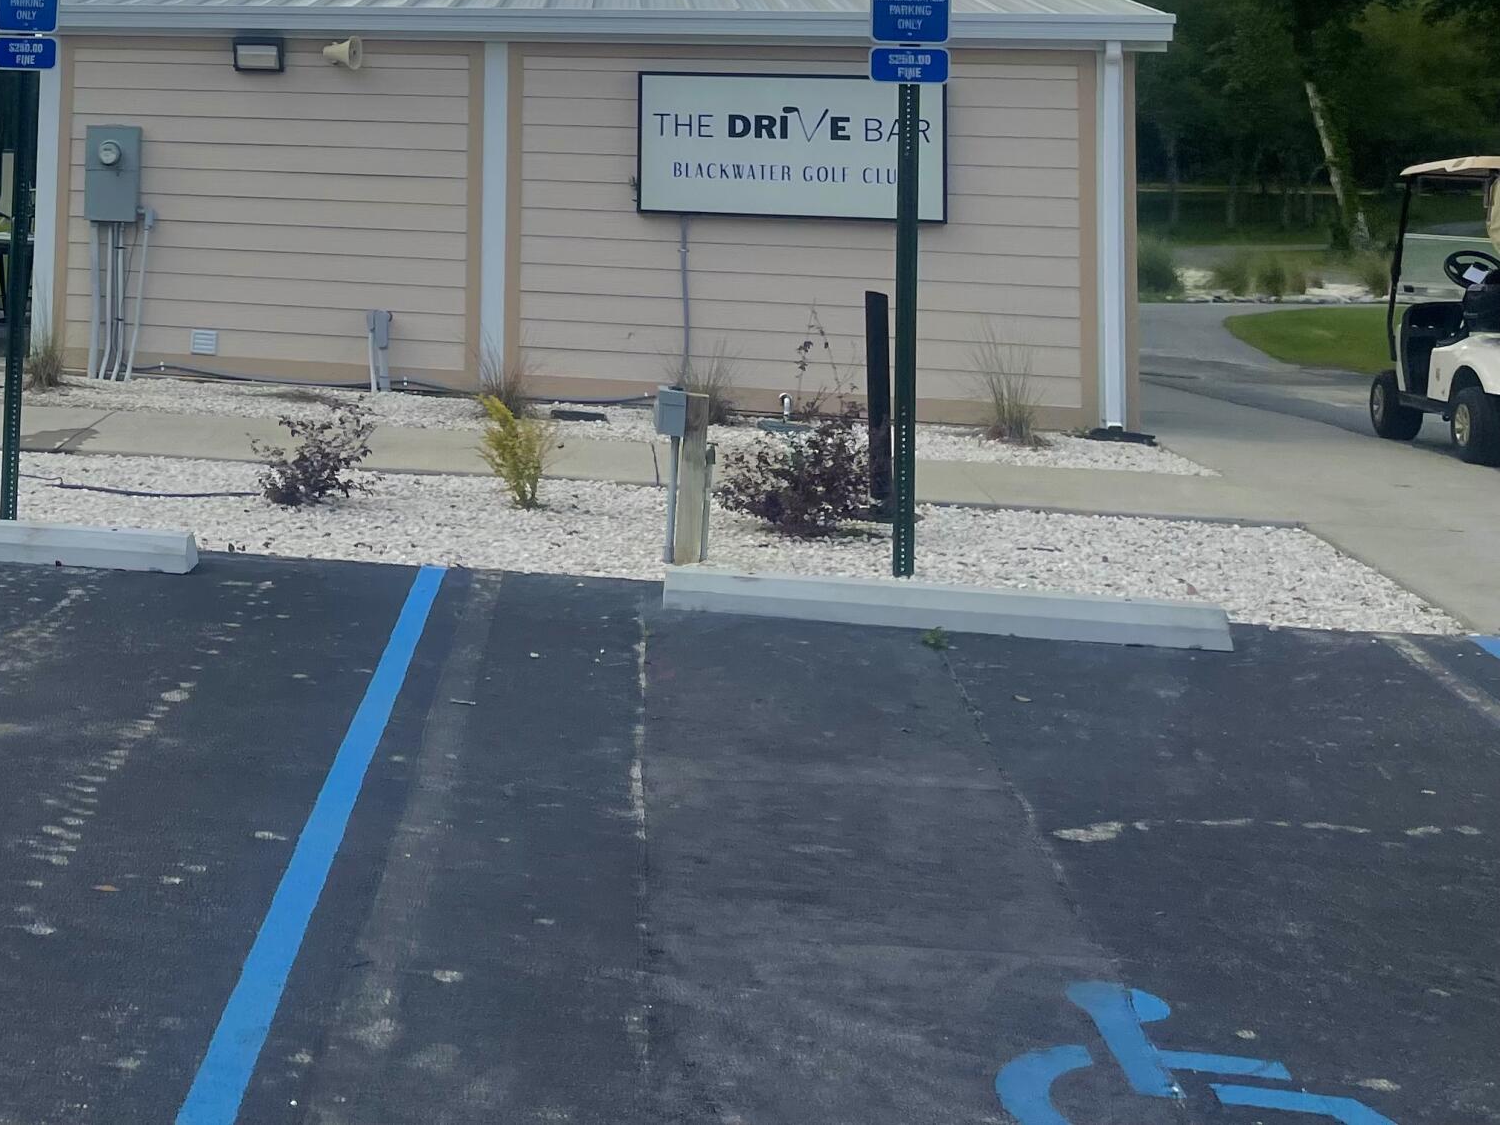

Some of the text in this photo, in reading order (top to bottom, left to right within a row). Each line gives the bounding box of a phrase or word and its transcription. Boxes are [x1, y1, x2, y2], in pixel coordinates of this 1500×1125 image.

[16, 10, 37, 20] ONLY
[889, 5, 933, 16] PARKING
[897, 18, 923, 30] ONLY
[15, 54, 36, 65] FINE
[897, 67, 922, 78] FINE
[652, 113, 714, 138] THE
[727, 106, 851, 143] DRIVE
[672, 161, 898, 185] BLACKWATER GOLF CLU
